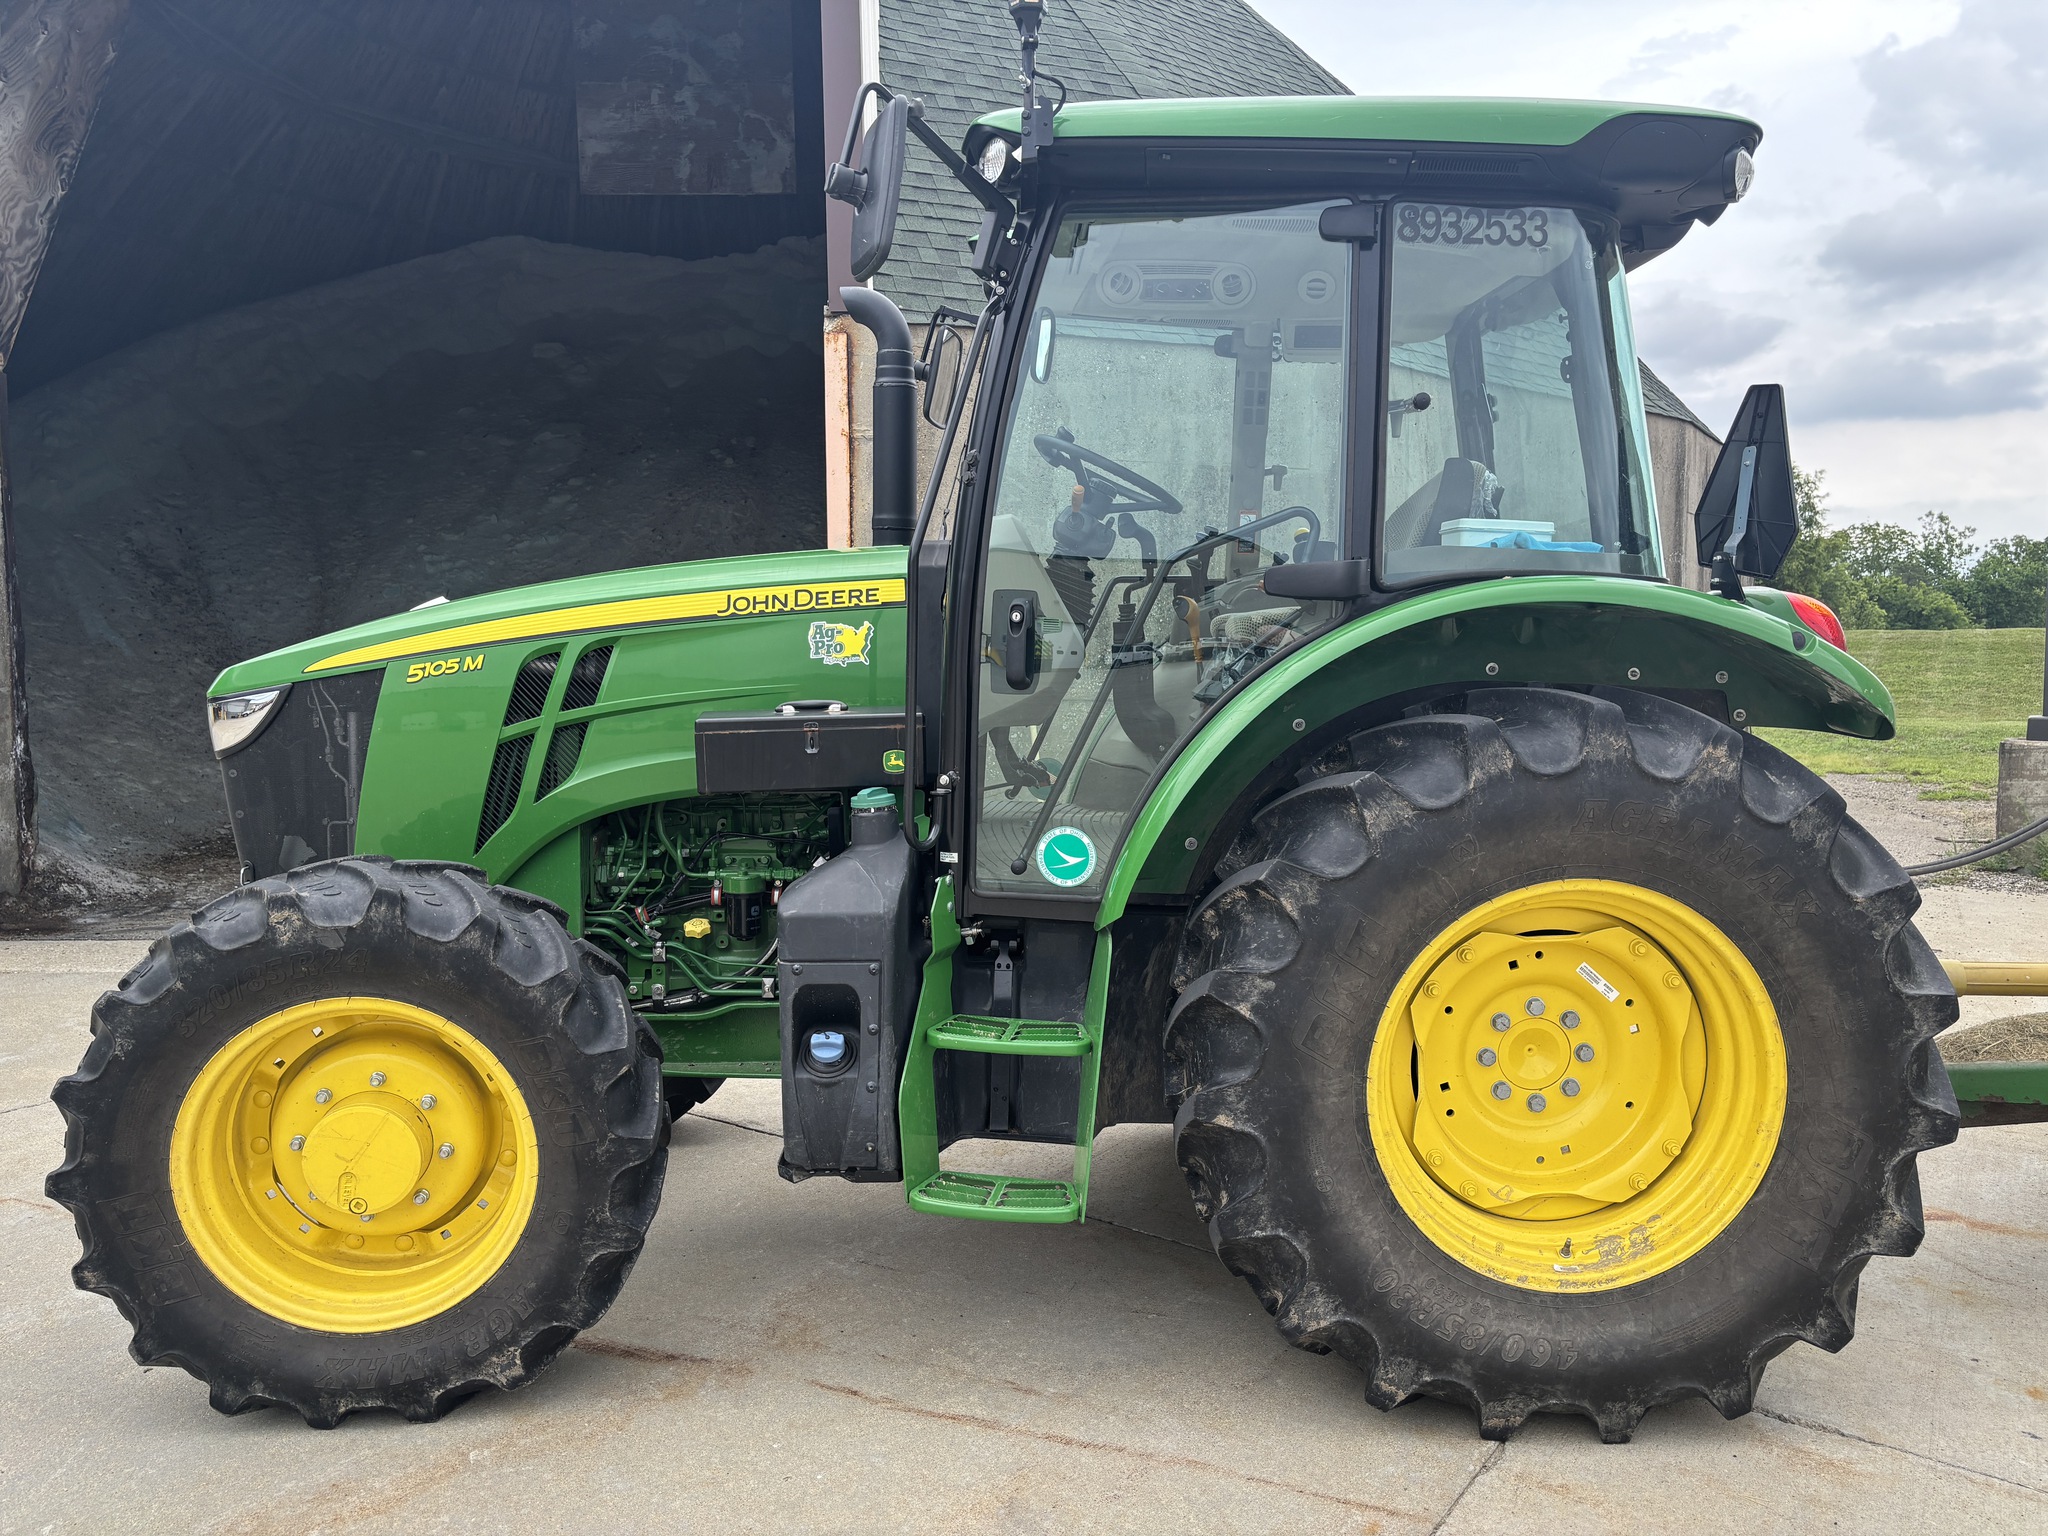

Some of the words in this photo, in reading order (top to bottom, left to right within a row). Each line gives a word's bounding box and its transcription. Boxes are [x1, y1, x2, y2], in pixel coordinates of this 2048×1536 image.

[1398, 204, 1548, 247] 8932533
[717, 594, 788, 614] JOHN
[794, 588, 880, 608] DEERE
[811, 624, 843, 642] Ag-
[813, 640, 844, 656] Pro
[406, 657, 461, 684] 5105
[462, 654, 485, 672] M
[1042, 830, 1057, 846] STATE
[1069, 829, 1085, 840] OHIO
[1038, 849, 1059, 884] DEPARTMENT
[1071, 842, 1095, 885] TRANSPORTATION
[170, 948, 369, 1038] 320/85R24
[1297, 912, 1385, 1064] BKT
[1373, 1269, 1578, 1370] 460/85R30
